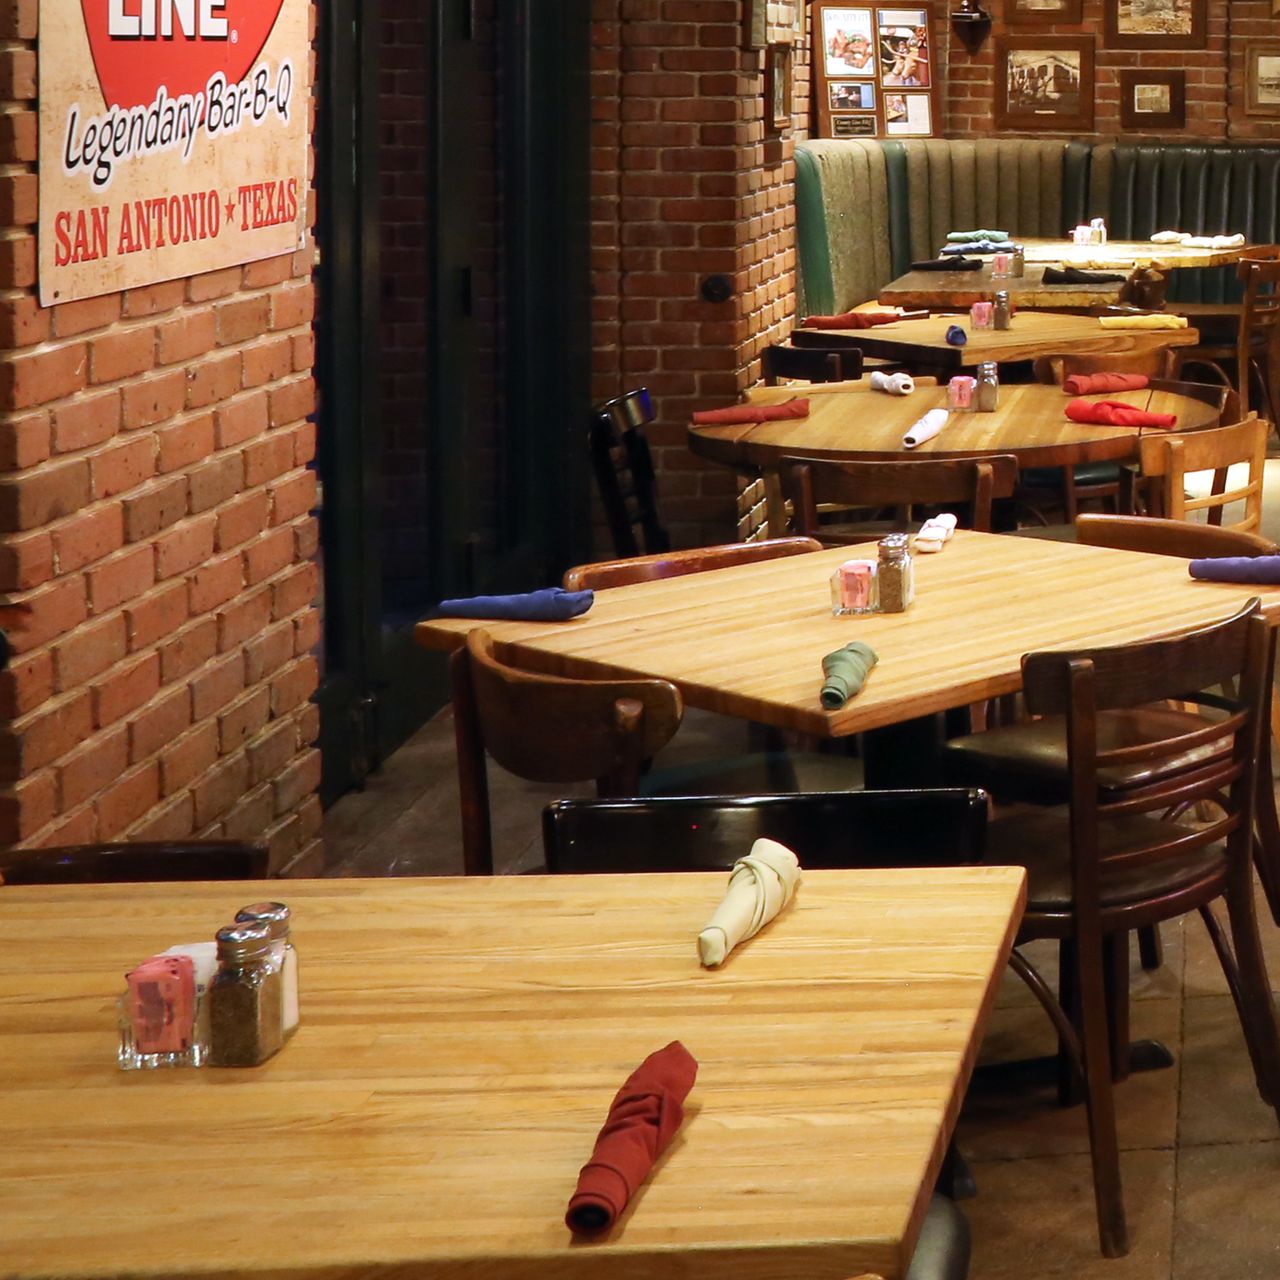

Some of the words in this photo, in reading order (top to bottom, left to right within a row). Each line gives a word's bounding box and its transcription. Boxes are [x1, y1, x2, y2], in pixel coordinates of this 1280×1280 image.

[64, 92, 202, 186] Legendary
[207, 63, 293, 133] Bar-B-Q
[55, 205, 110, 267] SAN
[117, 189, 221, 255] ANTONIO
[237, 177, 298, 231] TEXAS
